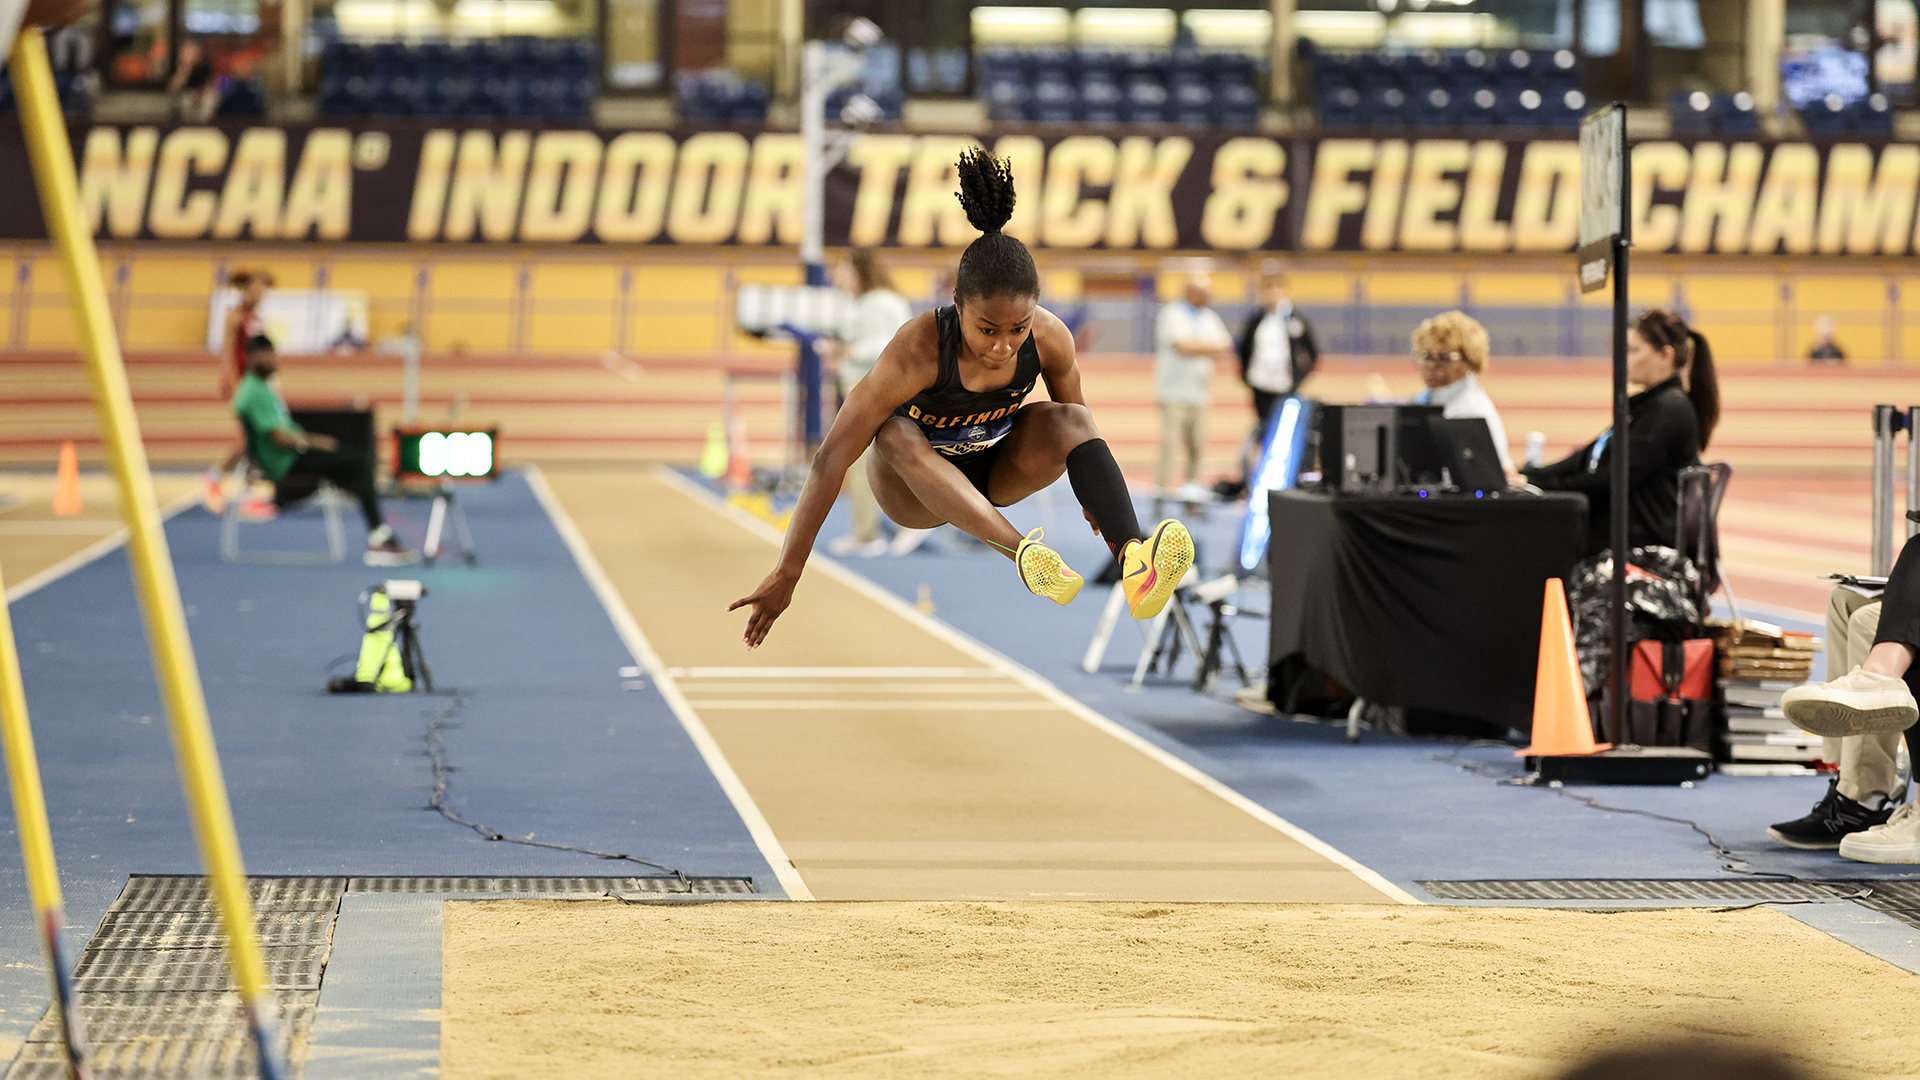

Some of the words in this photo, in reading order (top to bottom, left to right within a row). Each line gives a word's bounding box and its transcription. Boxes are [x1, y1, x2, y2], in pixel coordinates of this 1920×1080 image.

[407, 129, 802, 242] INDOOR
[1203, 137, 1288, 249] &
[1303, 140, 1582, 250] FIELD
[1631, 142, 1920, 253] CHAM
